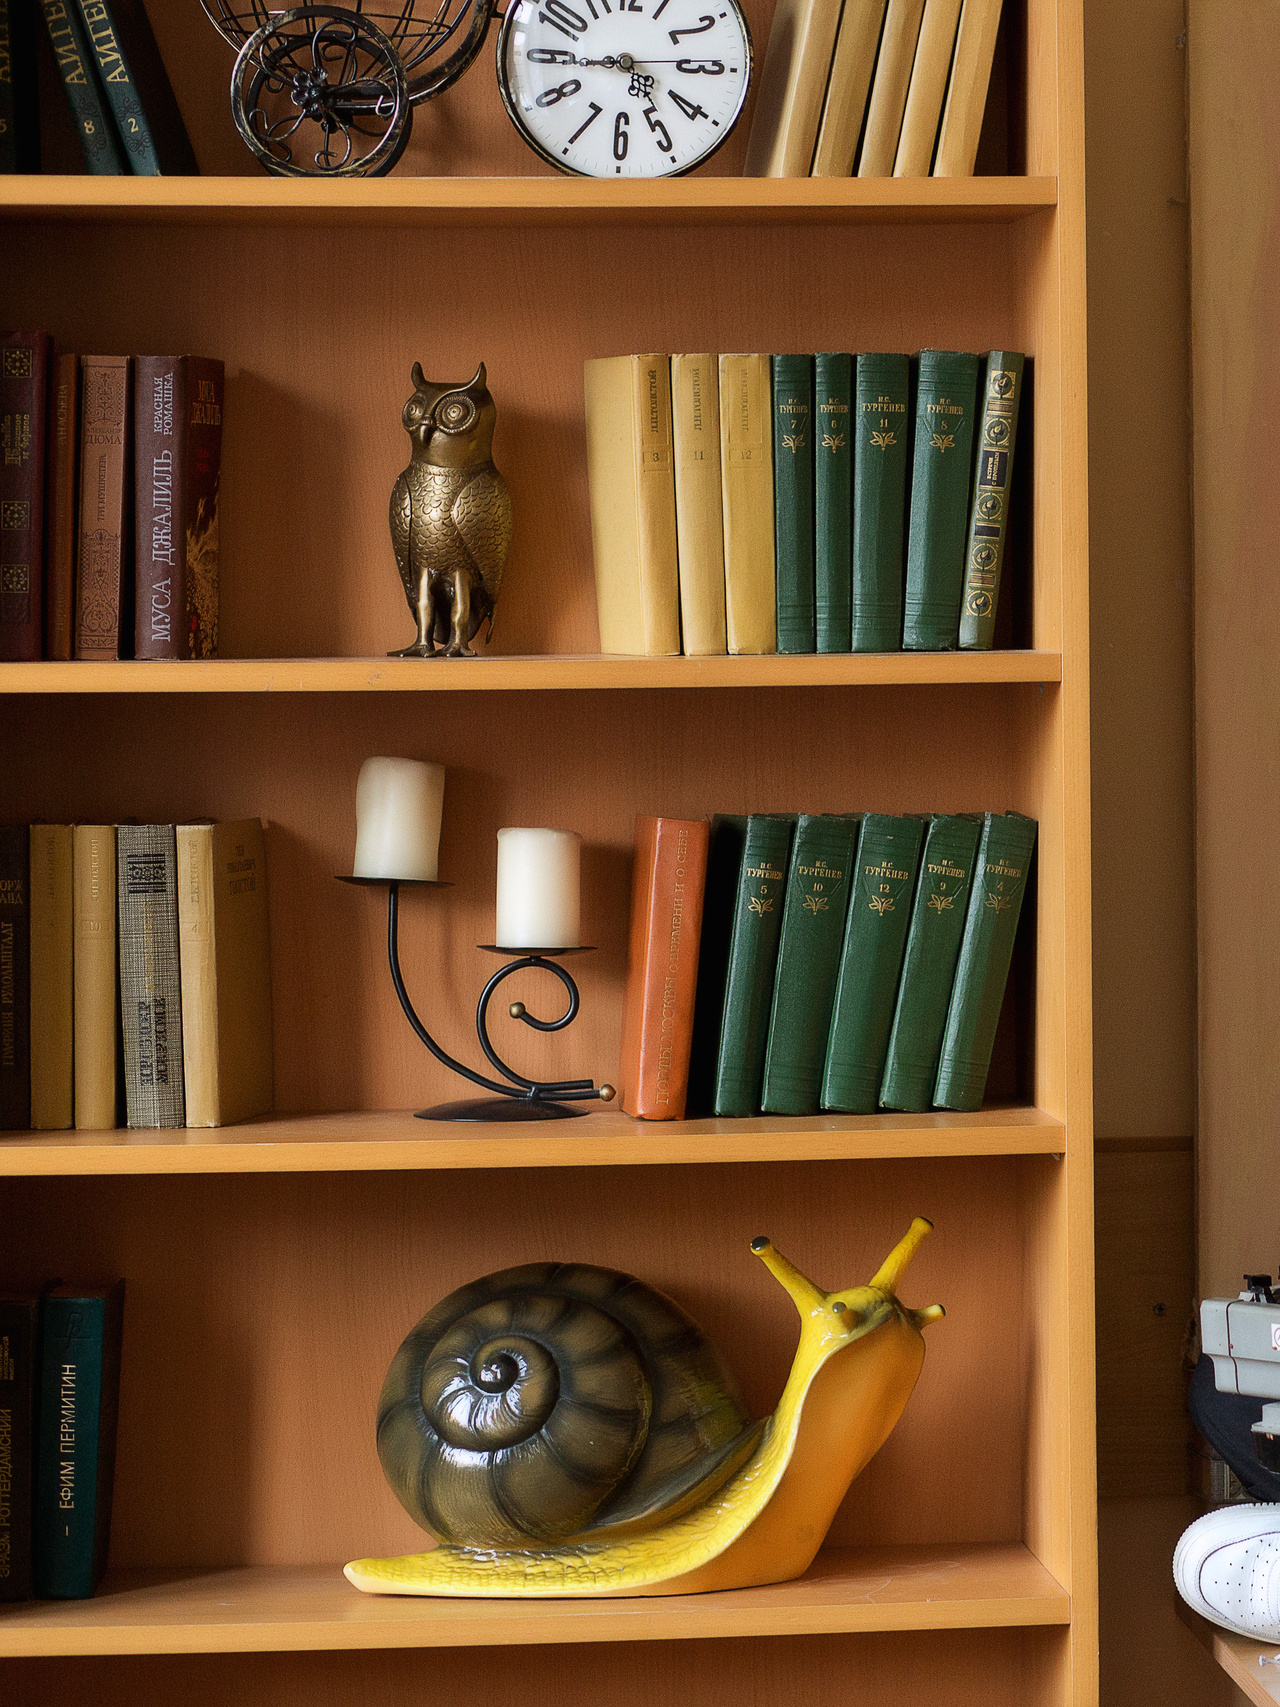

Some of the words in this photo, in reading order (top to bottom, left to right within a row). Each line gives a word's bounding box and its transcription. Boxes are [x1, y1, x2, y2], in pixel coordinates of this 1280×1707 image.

[538, 0, 588, 42] 10
[668, 15, 716, 46] 2
[675, 58, 726, 76] 3
[535, 78, 582, 108] 8
[667, 89, 710, 121] 4
[83, 119, 95, 134] 8
[127, 117, 139, 133] 2
[567, 101, 603, 145] 7
[642, 106, 674, 153] 5
[612, 111, 630, 161] 6
[153, 376, 164, 434] КРАСНАЯ
[163, 372, 174, 436] РОМАШКА
[779, 404, 808, 414] ТУРГЕНЕВ
[819, 404, 848, 414] ТУРГЕНЕВ
[861, 402, 906, 412] ТУРГЕНЕВ
[926, 404, 964, 415] ТУРГЕНЕВ
[790, 420, 797, 429] 7
[831, 420, 837, 428] 6
[879, 418, 888, 428] 11
[940, 420, 948, 430] 8
[85, 434, 123, 445] ДЮМА
[652, 452, 660, 462] 3
[693, 450, 704, 461] 11
[740, 450, 752, 460] 12
[97, 506, 106, 522] ТРИ
[151, 449, 176, 566] ДЖАЛИЛЬ
[151, 577, 172, 643] МУСА
[676, 830, 689, 864] СЕБЕ
[675, 868, 686, 877] О
[746, 866, 783, 879] ТУРГЕНЕВ
[798, 864, 842, 878] ТУРГЕНЕВ
[864, 865, 909, 880] ТУРГЕНЕВ
[927, 863, 966, 878] ТУРГЕНЕВ
[985, 863, 1022, 878] ТУРГЕНЕВ
[674, 882, 685, 894] И
[760, 884, 767, 894] 5
[813, 881, 823, 891] 10
[879, 883, 890, 893] 12
[939, 881, 946, 891] 9
[996, 881, 1003, 891] 4
[670, 898, 684, 962] ВРЕМЕНИ
[668, 963, 679, 973] О
[660, 976, 678, 1042] МОСКВЫ
[656, 1046, 675, 1105] ПОЭТЫ
[60, 1363, 77, 1453] ПЕРМИТИН
[59, 1461, 75, 1509] ЕФИМ
